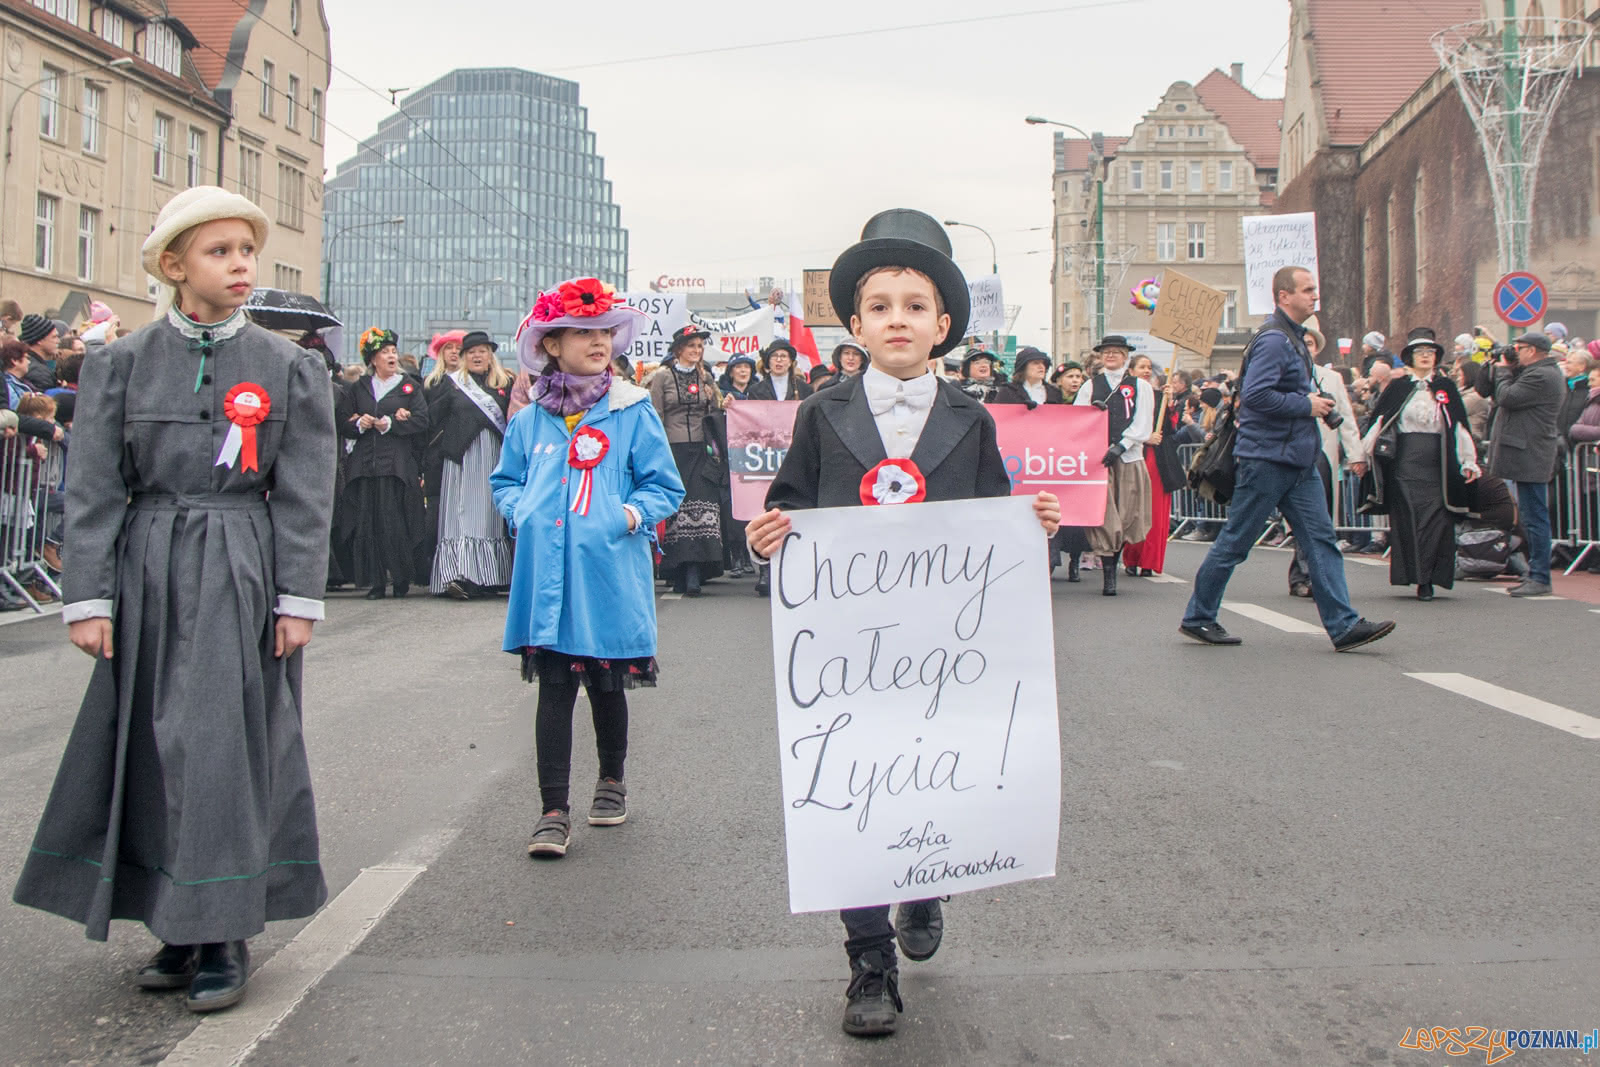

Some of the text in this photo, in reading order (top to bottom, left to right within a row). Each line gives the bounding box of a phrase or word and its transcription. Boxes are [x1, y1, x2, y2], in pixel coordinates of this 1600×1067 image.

[657, 274, 706, 289] Centra
[1168, 279, 1225, 320] CHCEMY
[778, 532, 1024, 641] Chcemy
[788, 623, 987, 720] Całego
[888, 821, 952, 853] Zofia
[894, 847, 1024, 889] Nałkowska
